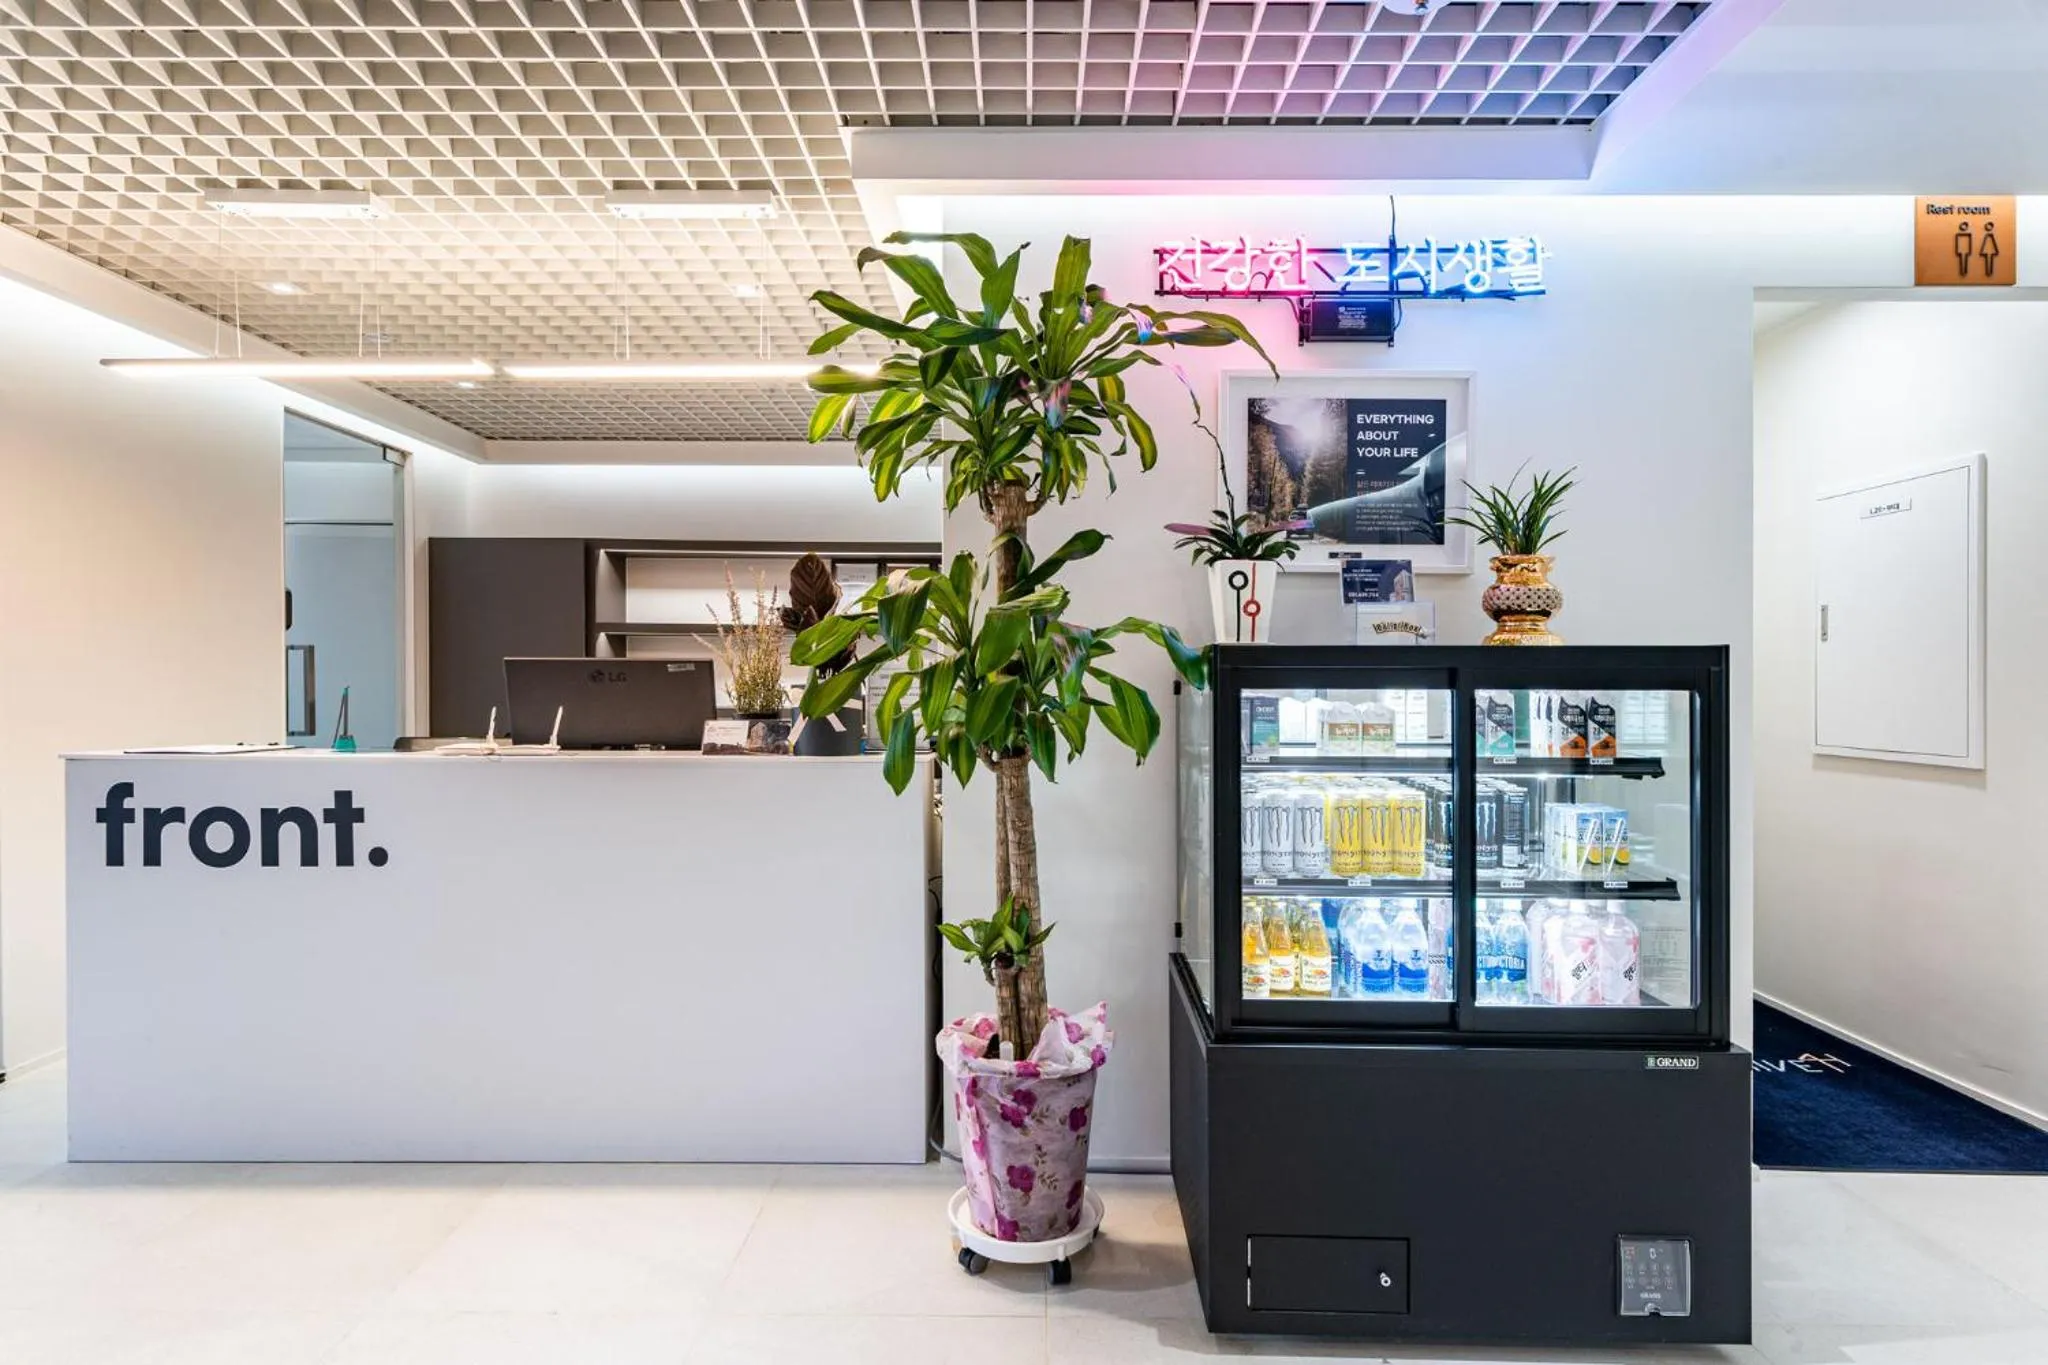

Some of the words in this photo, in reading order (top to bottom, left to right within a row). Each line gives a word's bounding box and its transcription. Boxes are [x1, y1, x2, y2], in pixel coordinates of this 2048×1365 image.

[1926, 203, 1953, 215] Rest
[1957, 205, 1991, 215] room
[1159, 234, 1318, 292] 건강한
[1335, 234, 1552, 294] 도시생활
[1356, 414, 1435, 424] EVERYTHING
[1356, 430, 1400, 441] ABOUT
[1356, 447, 1391, 457] YOUR
[1393, 448, 1419, 458] LIFE
[608, 672, 627, 683] LG
[95, 781, 389, 868] front.
[1656, 1057, 1697, 1067] GRAND
